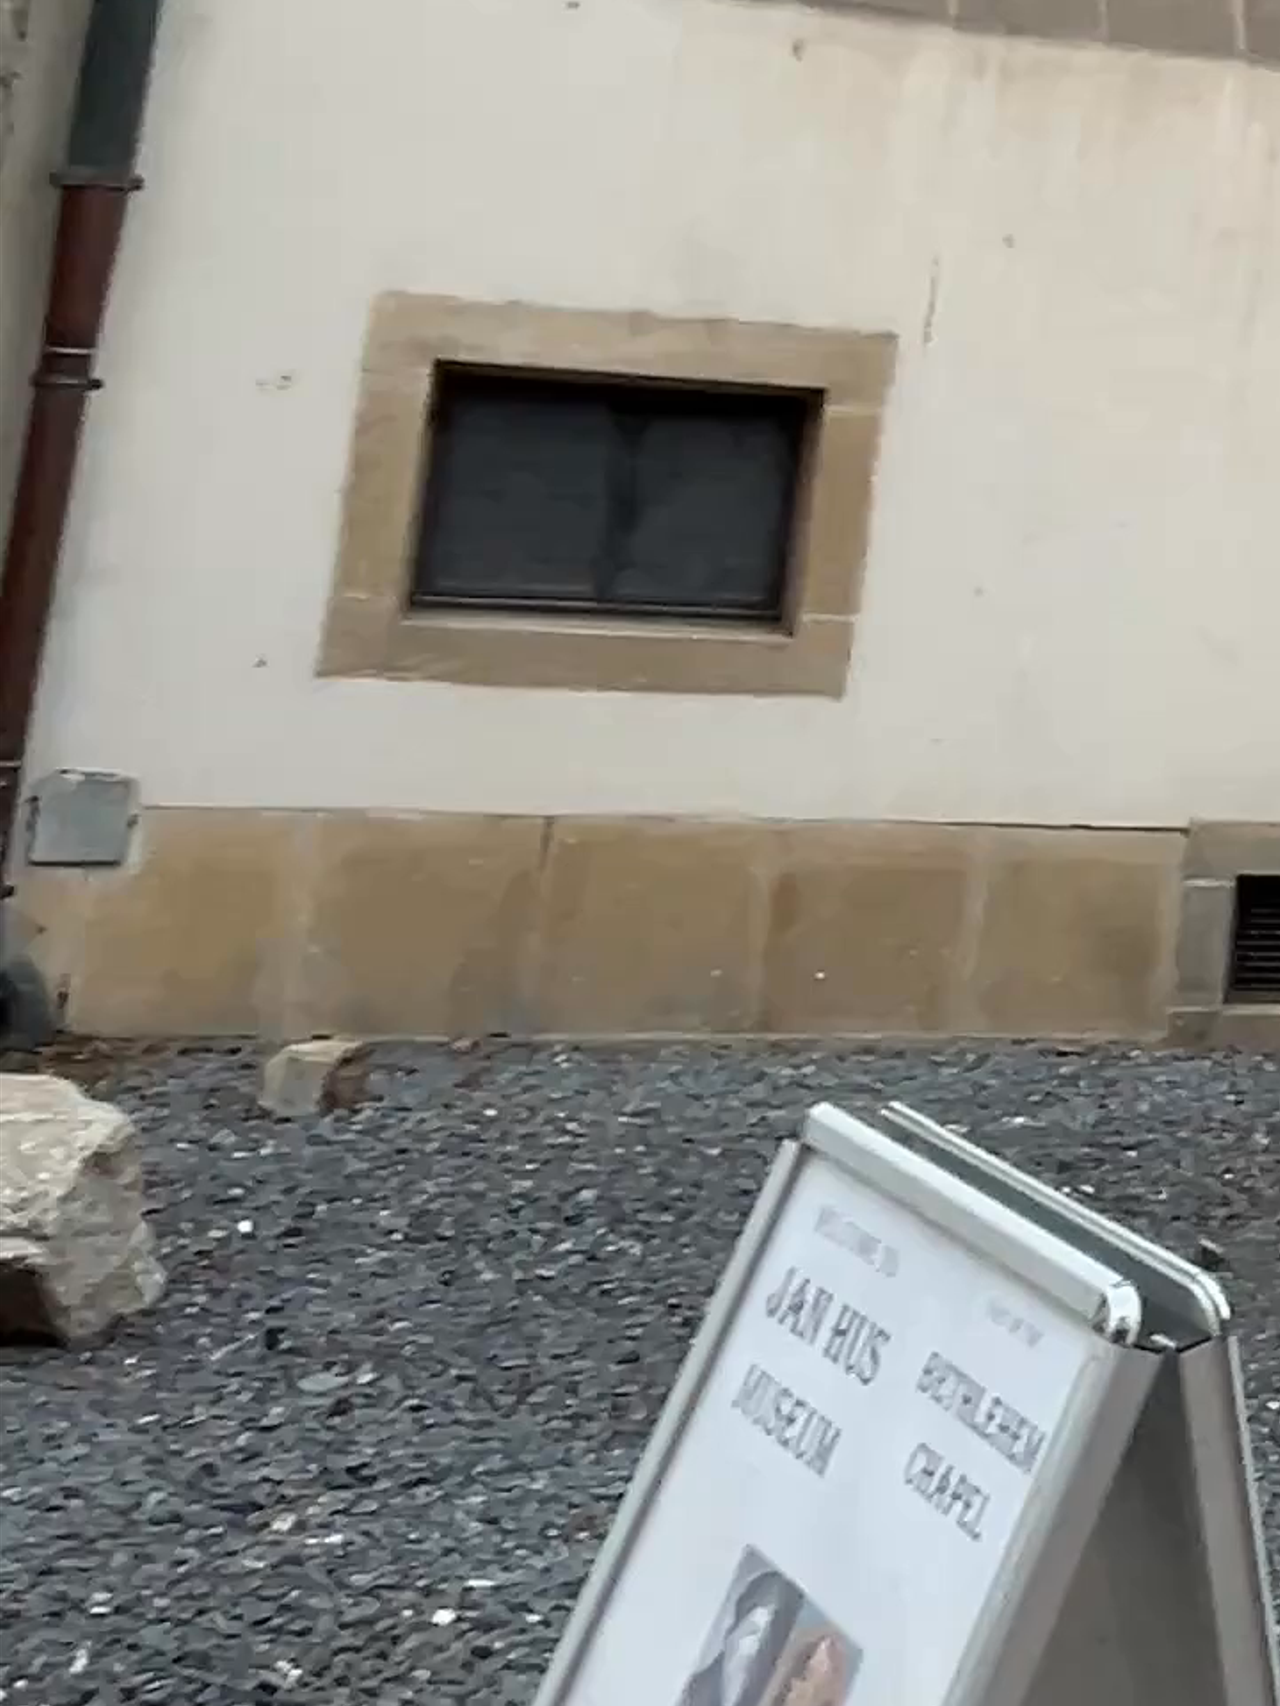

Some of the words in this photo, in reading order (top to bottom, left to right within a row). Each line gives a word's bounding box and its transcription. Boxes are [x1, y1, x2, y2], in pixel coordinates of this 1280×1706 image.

[765, 1265, 834, 1346] JAN
[822, 1302, 892, 1386] HUS
[904, 1441, 991, 1541] CHAPEL
